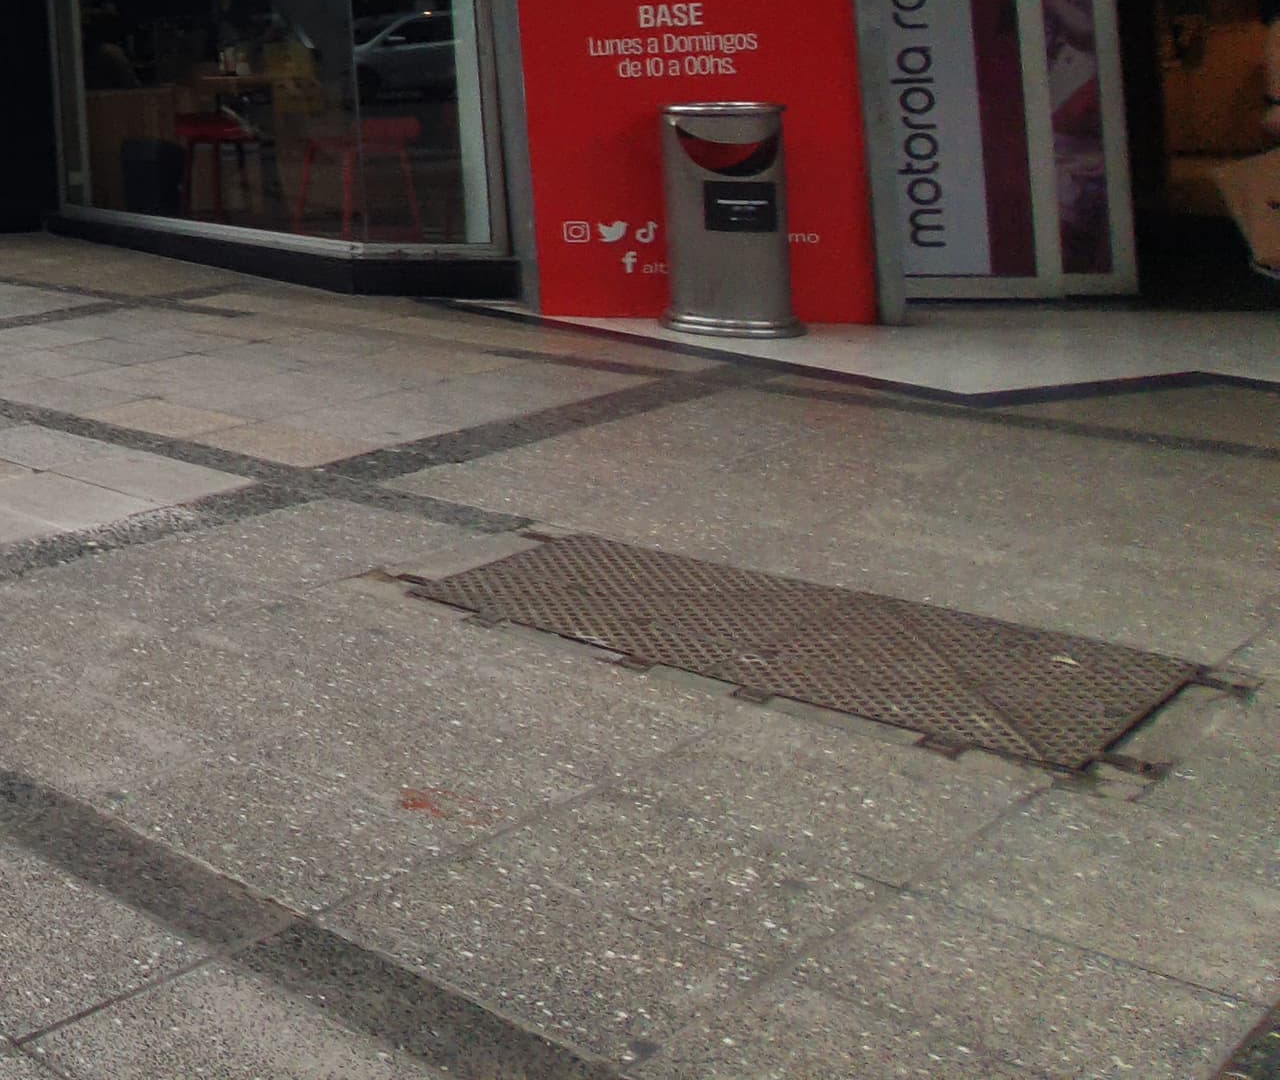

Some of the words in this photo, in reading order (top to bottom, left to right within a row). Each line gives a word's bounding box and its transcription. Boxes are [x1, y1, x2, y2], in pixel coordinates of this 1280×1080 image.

[638, 2, 704, 28] BASE
[588, 36, 643, 56] Lunes
[647, 37, 659, 54] a
[663, 31, 759, 53] Domingos
[618, 59, 641, 78] de
[668, 58, 681, 76] a
[890, 45, 947, 249] motorola
